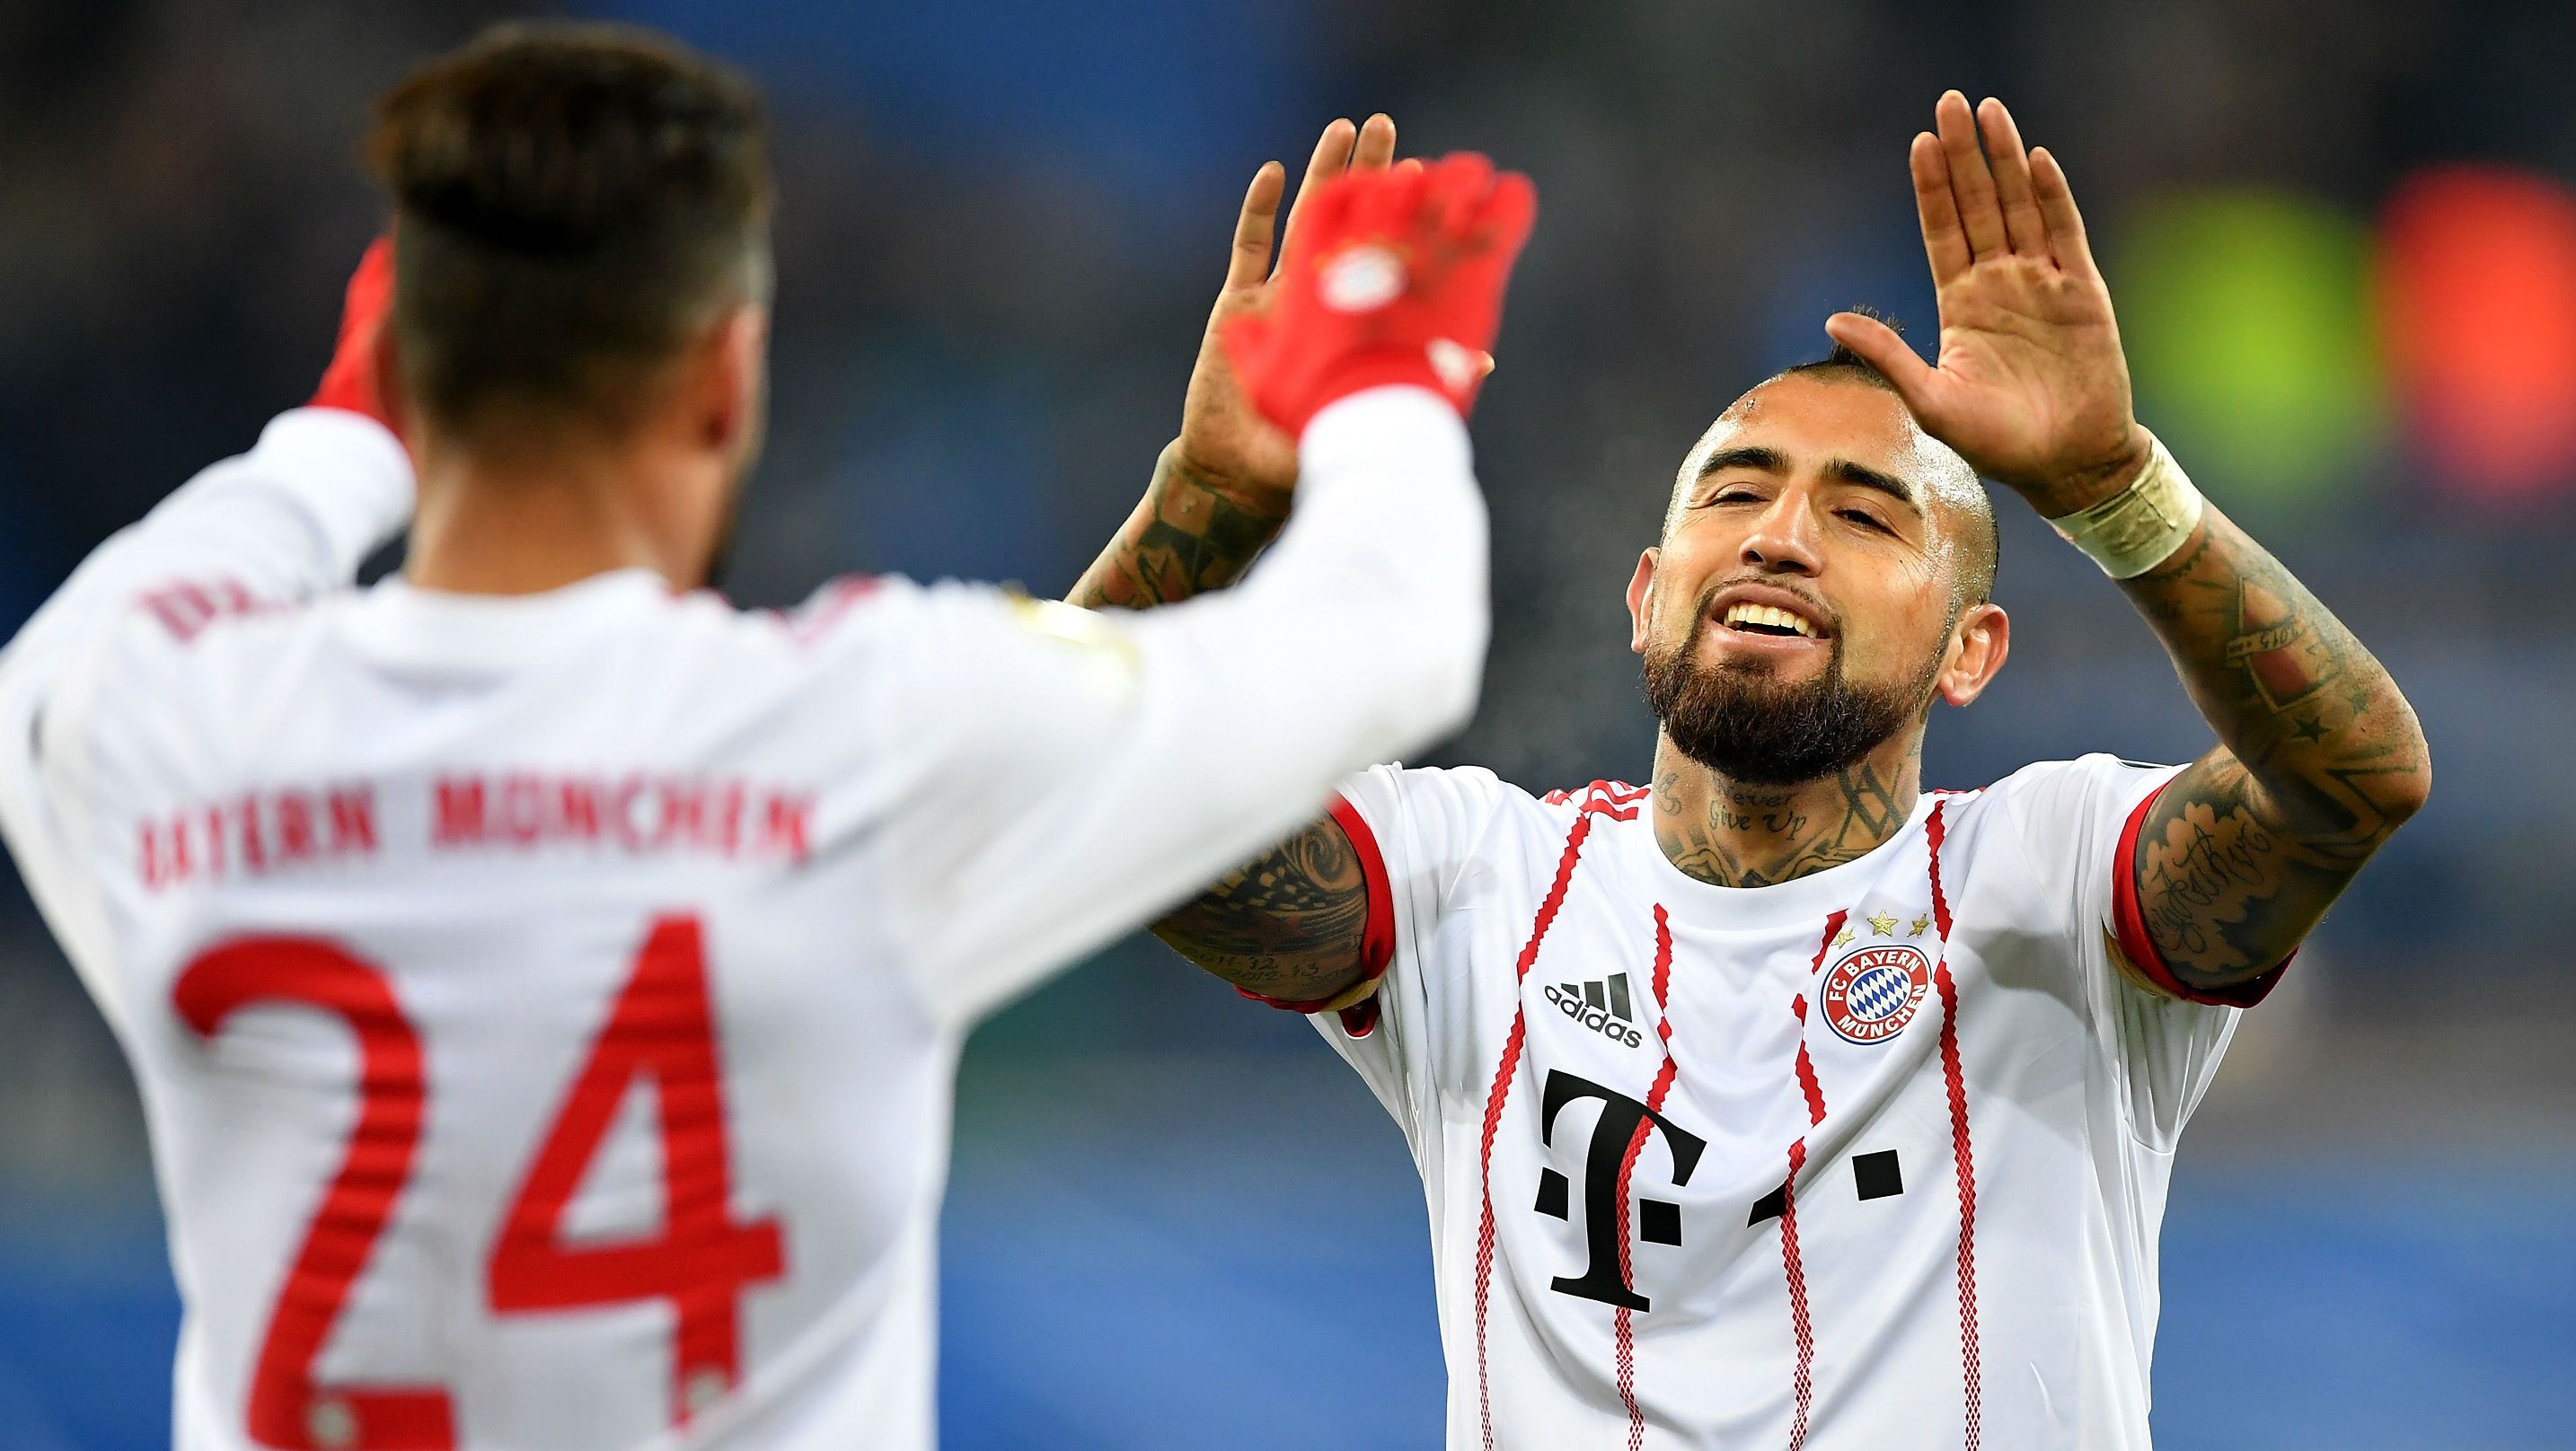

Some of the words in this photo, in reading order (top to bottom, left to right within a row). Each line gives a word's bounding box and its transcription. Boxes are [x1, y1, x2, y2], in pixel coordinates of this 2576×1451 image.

[1709, 799, 1751, 830] Give
[1762, 810, 1807, 841] Up
[1829, 978, 1847, 1001] FC
[1843, 951, 1920, 978] BAYERN
[1544, 985, 1642, 1048] adidas
[1837, 983, 1927, 1038] MÜNCHEN
[171, 910, 787, 1451] 24
